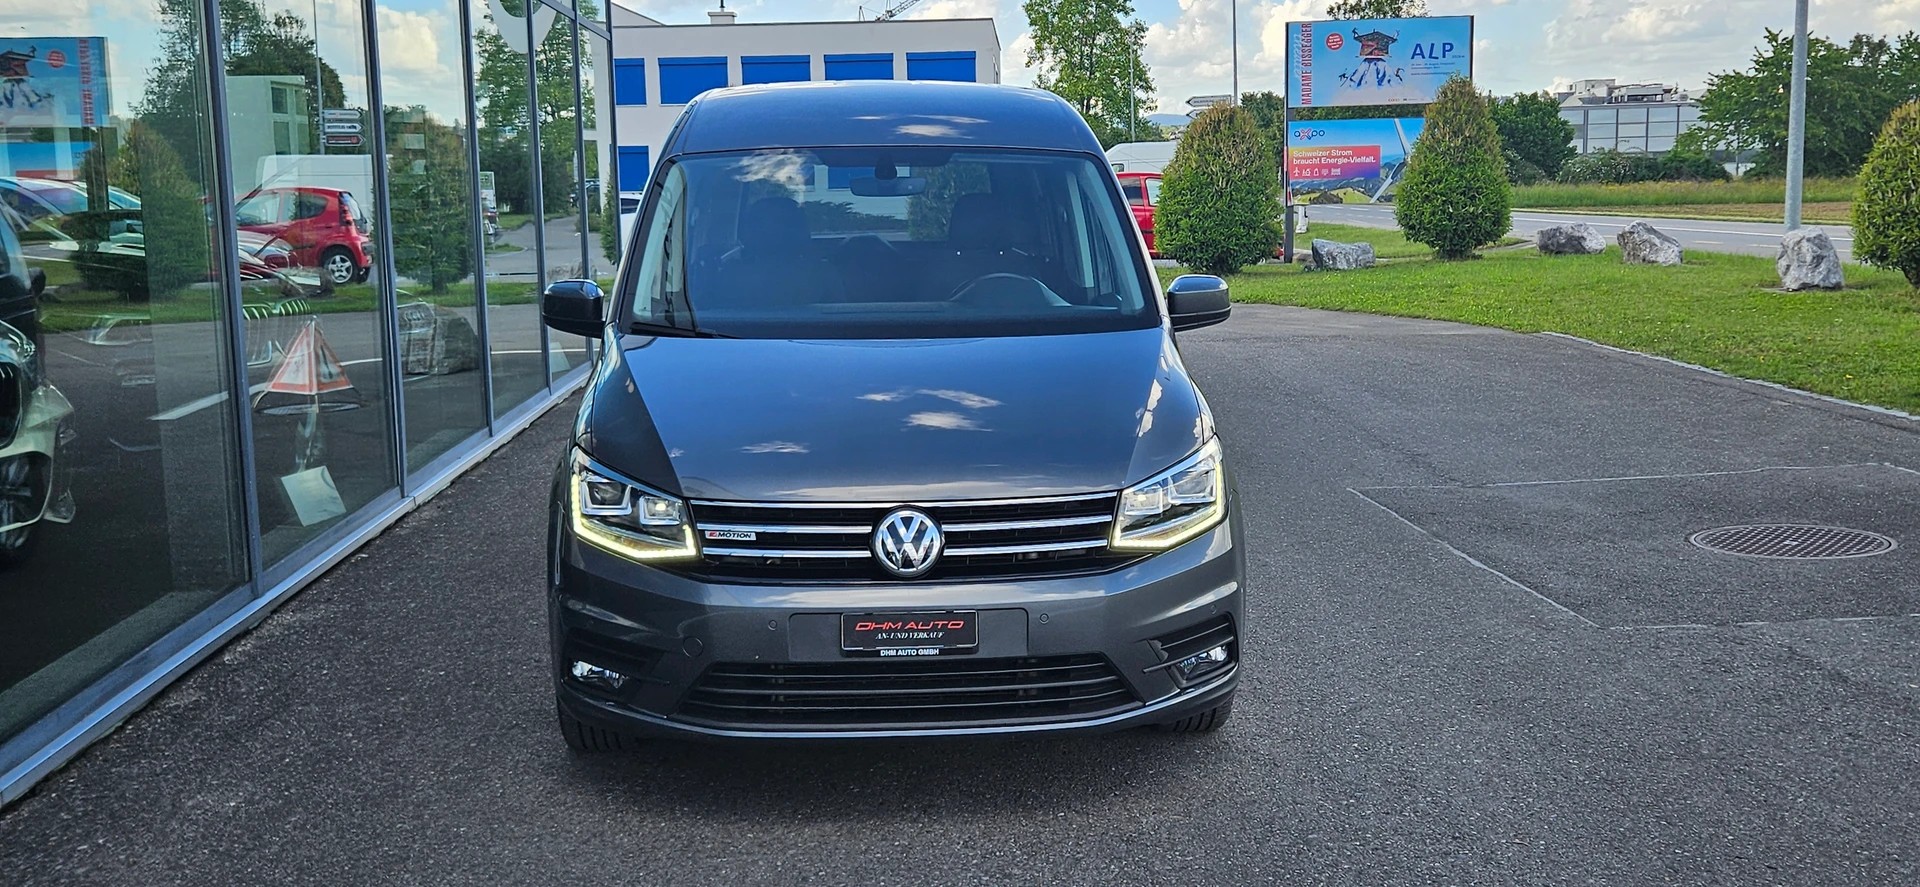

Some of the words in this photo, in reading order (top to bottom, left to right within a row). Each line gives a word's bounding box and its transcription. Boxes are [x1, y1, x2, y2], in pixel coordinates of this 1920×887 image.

[1301, 23, 1312, 67] BISSEGGER
[1410, 42, 1454, 60] ALP
[1301, 70, 1312, 105] MADAME
[1293, 150, 1329, 158] Schweizer
[882, 514, 937, 571] VW
[855, 622, 902, 631] DHM
[904, 620, 965, 630] AUTO
[909, 631, 945, 639] VERKAUF
[918, 648, 940, 656] GMBH
